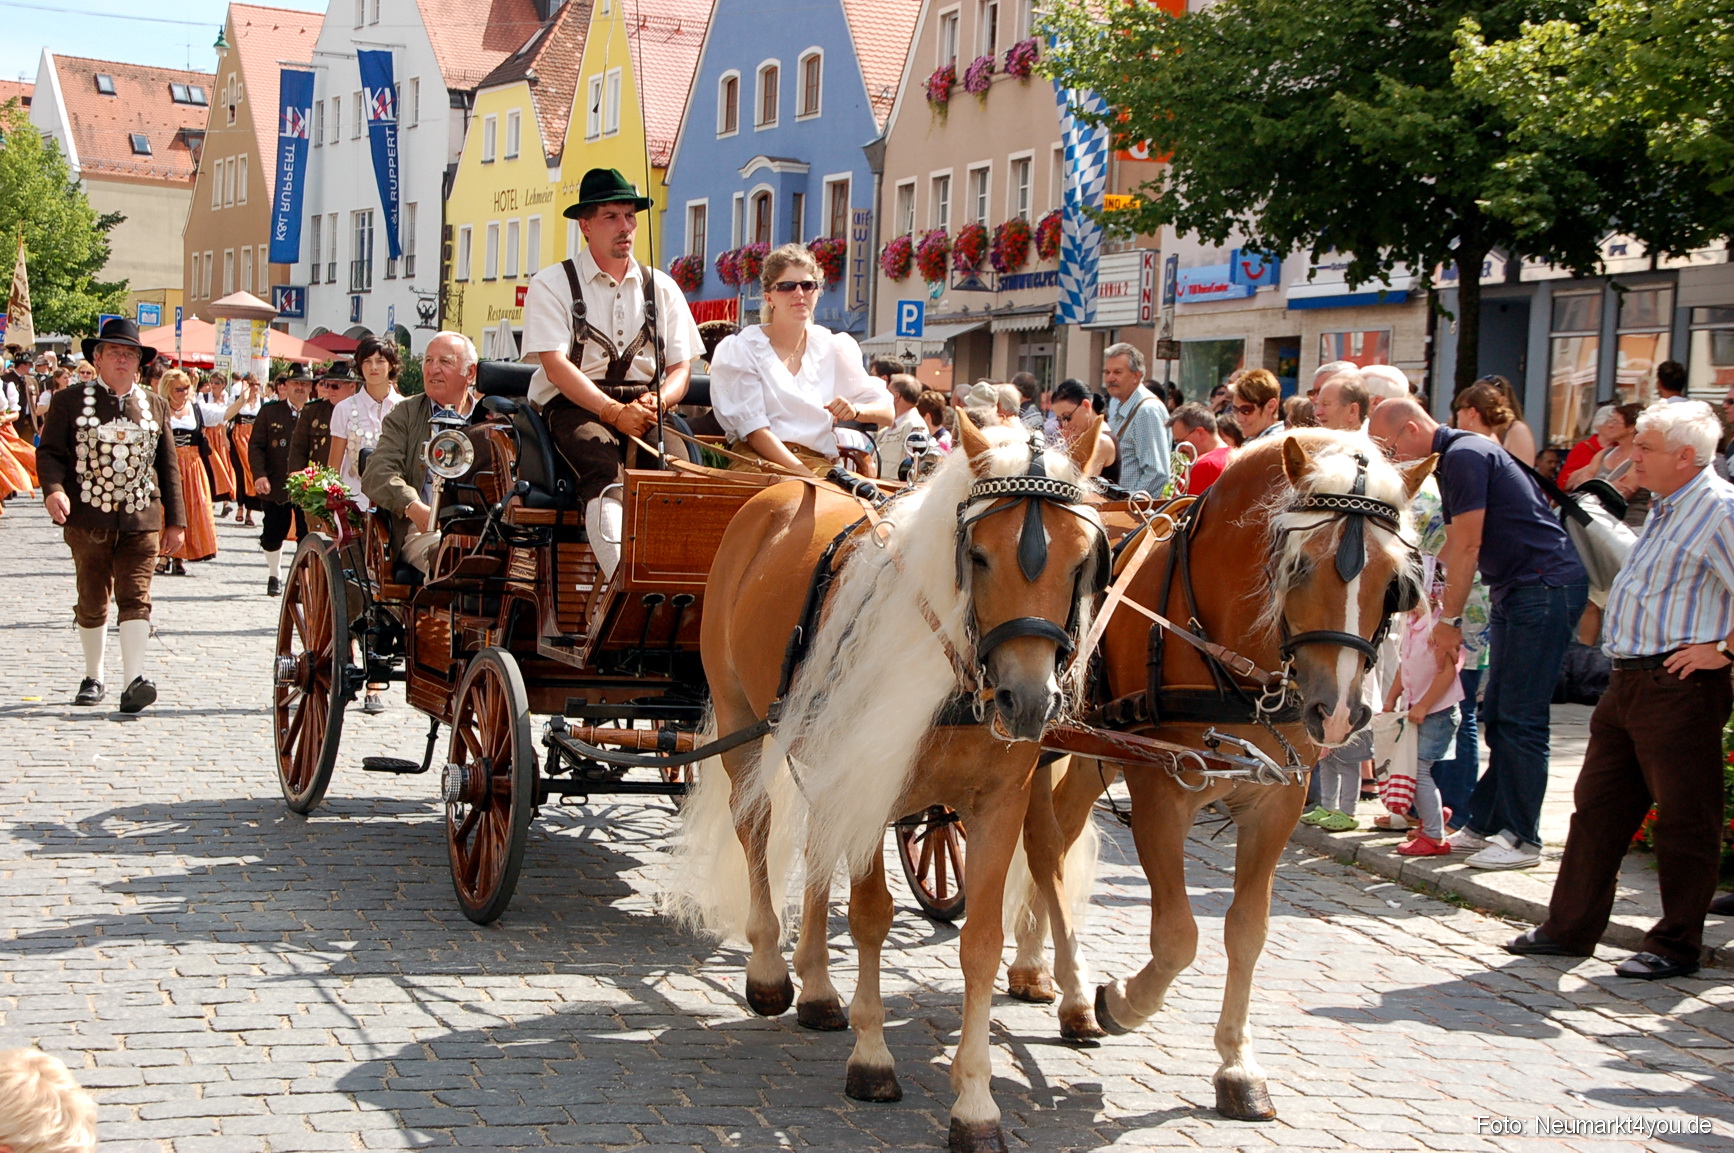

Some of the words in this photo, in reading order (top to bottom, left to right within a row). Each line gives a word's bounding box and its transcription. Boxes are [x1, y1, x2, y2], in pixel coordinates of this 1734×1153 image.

[386, 126, 397, 202] RUPPERT
[493, 189, 519, 213] HOTEL
[525, 187, 554, 207] Lehmeier
[1105, 198, 1121, 209] INO
[853, 228, 868, 304] WITTL
[1165, 262, 1175, 299] P
[1141, 254, 1153, 322] KINO
[176, 309, 182, 328] P
[487, 305, 523, 322] Restaurant
[902, 303, 919, 333] P
